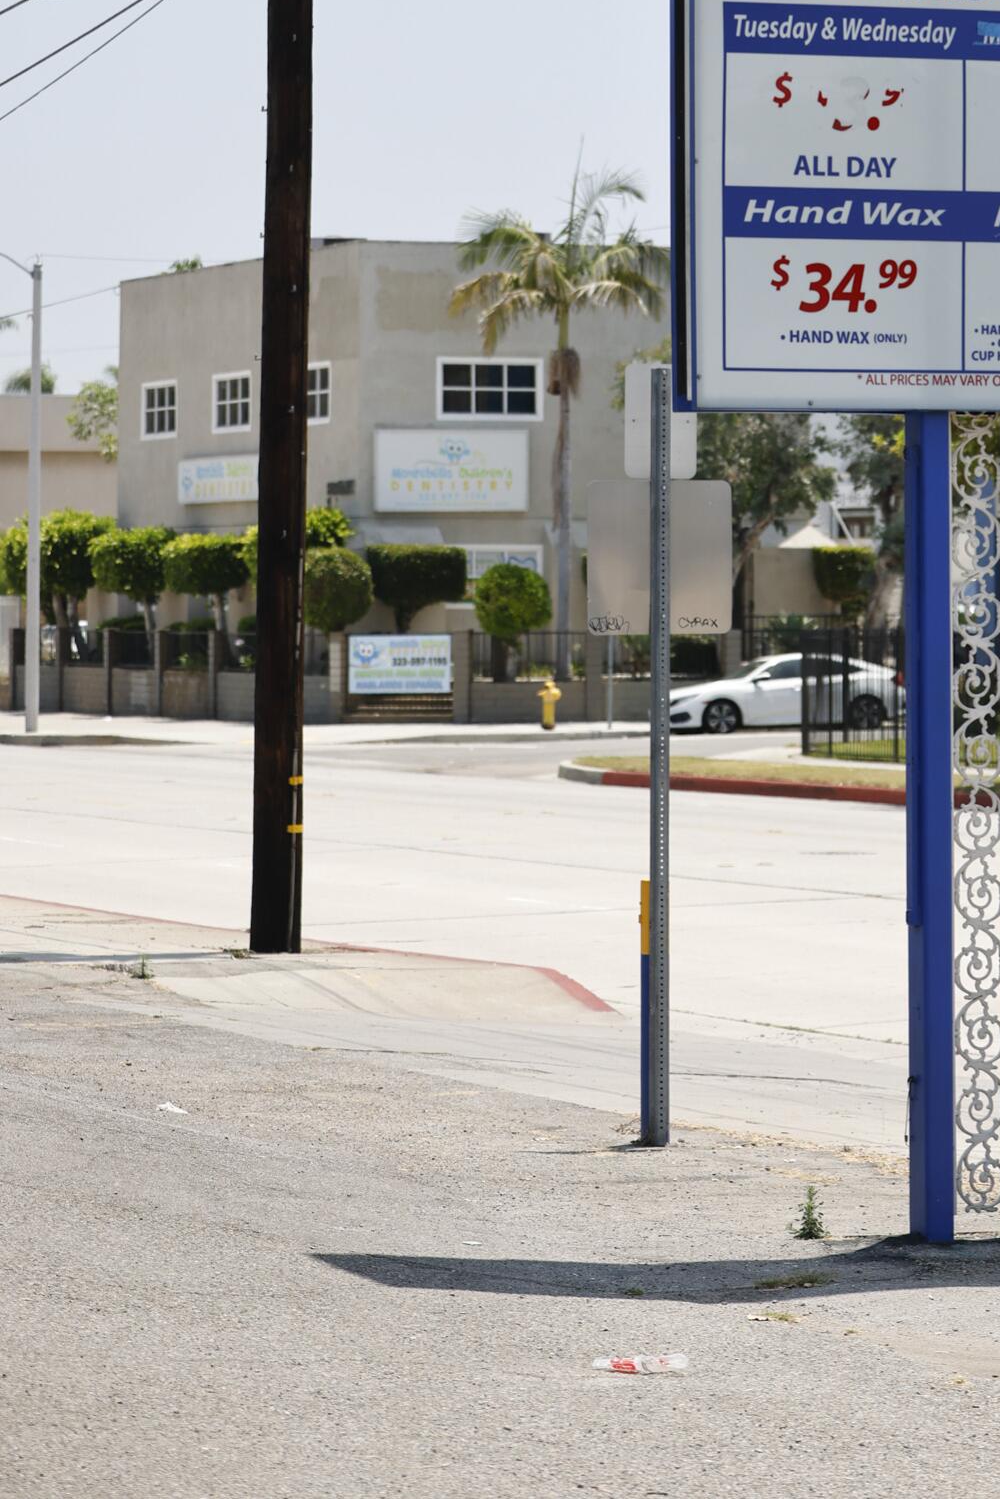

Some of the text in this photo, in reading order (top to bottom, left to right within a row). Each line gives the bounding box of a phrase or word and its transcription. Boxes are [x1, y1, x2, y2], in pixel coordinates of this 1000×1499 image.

[733, 14, 818, 46] Tuesday
[821, 16, 837, 41] &
[841, 17, 956, 51] Wednesday
[793, 155, 897, 178] ALL DAY
[744, 198, 946, 227] Hand Wax
[789, 330, 907, 344] HAND WAX (ONLY)
[971, 350, 997, 361] CUP
[865, 374, 887, 385] ALL
[889, 374, 929, 386] PRICES
[931, 374, 957, 386] MAY
[960, 375, 990, 387] VARY
